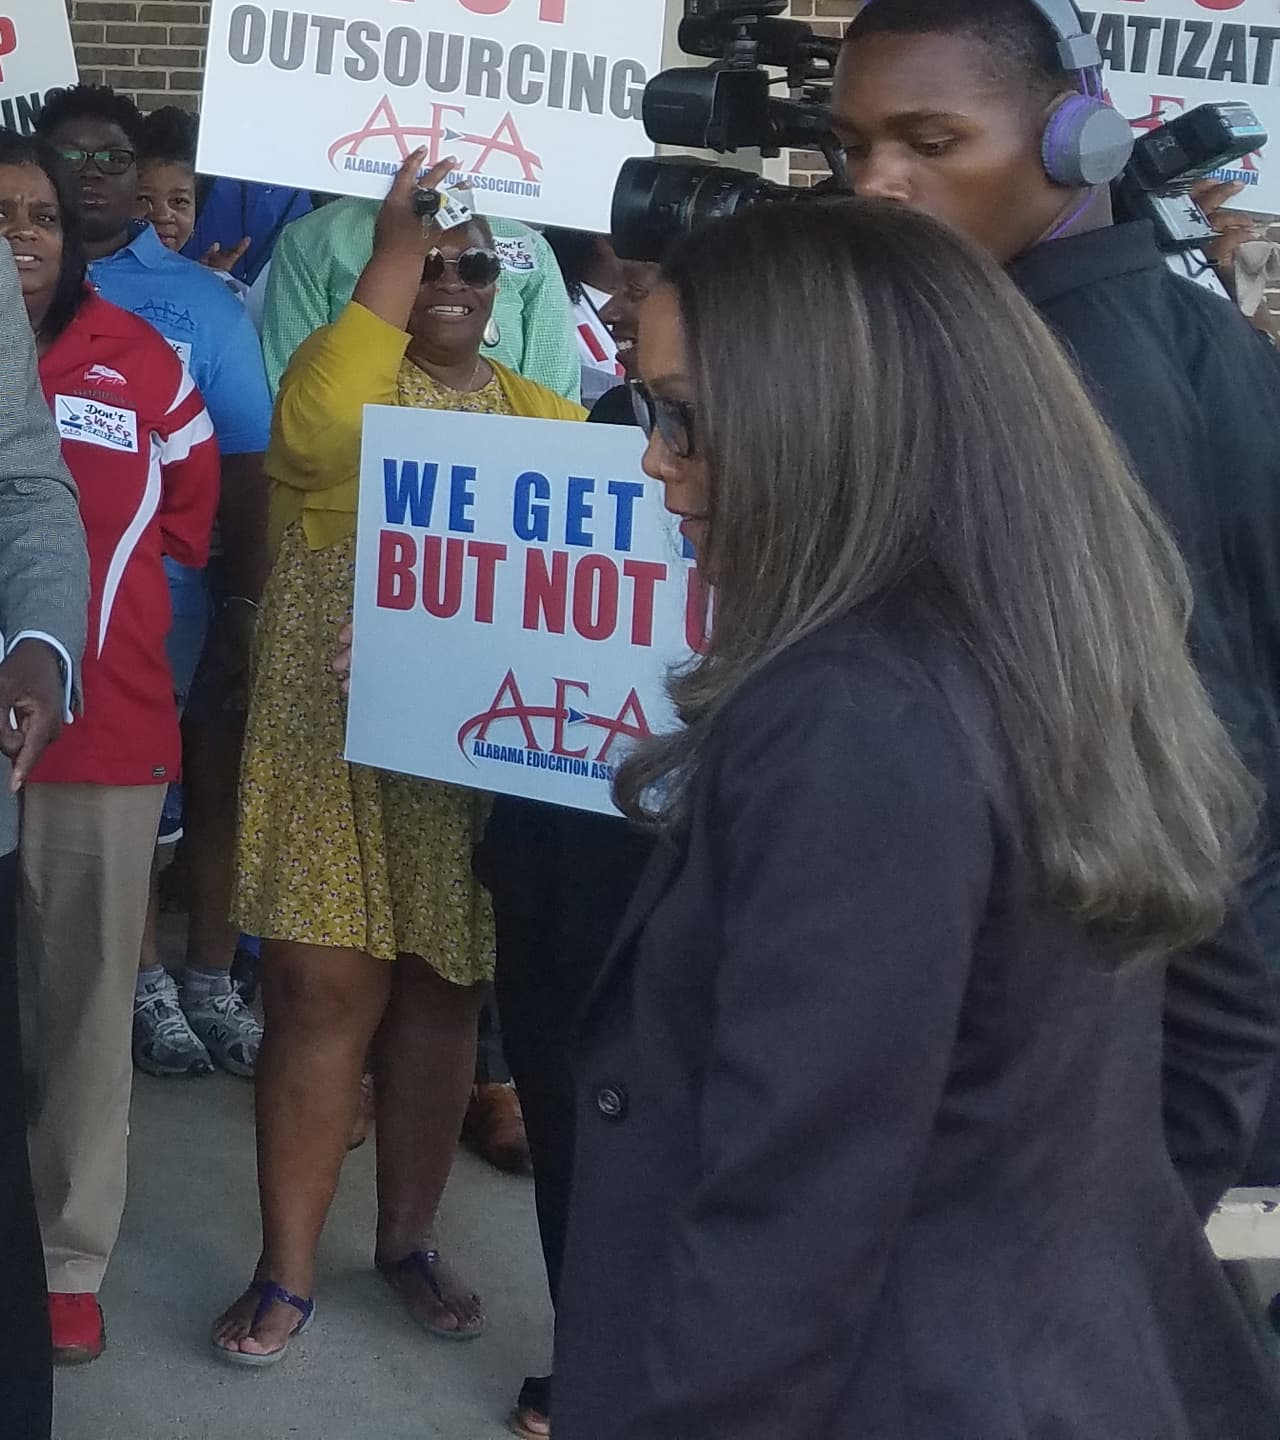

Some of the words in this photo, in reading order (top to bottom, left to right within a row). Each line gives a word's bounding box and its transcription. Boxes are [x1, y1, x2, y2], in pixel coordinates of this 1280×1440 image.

[227, 3, 648, 121] OUTSOURCING
[83, 415, 132, 440] SWEEP
[84, 403, 127, 423] Don't
[382, 457, 477, 533] WE
[512, 470, 644, 552] GET
[376, 529, 507, 624] BUT
[522, 547, 667, 647] NOT
[473, 740, 524, 765] ALABAMA
[526, 751, 589, 777] EDUCATION
